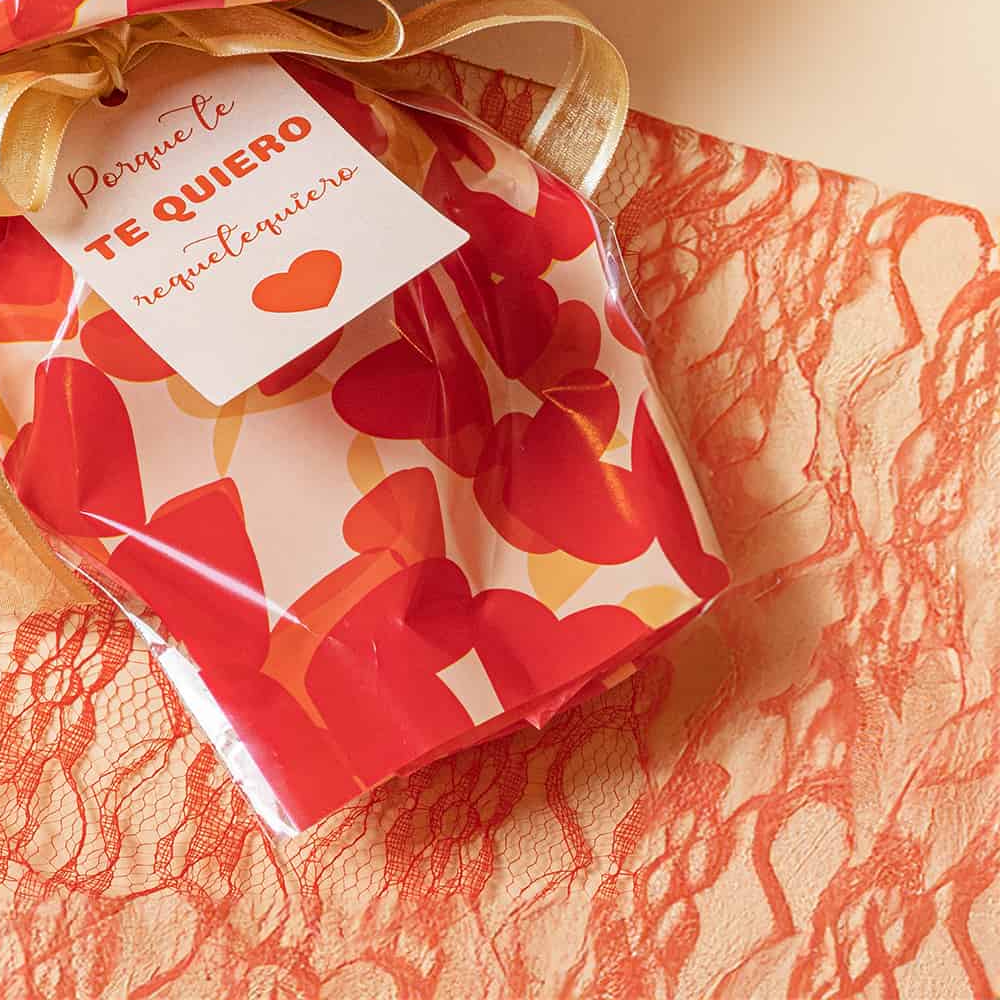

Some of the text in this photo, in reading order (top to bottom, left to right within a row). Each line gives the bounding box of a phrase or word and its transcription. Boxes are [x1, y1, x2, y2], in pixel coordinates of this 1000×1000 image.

[67, 94, 235, 210] Porque te
[84, 116, 312, 261] TE QUIERO
[133, 165, 359, 307] requetequiero
